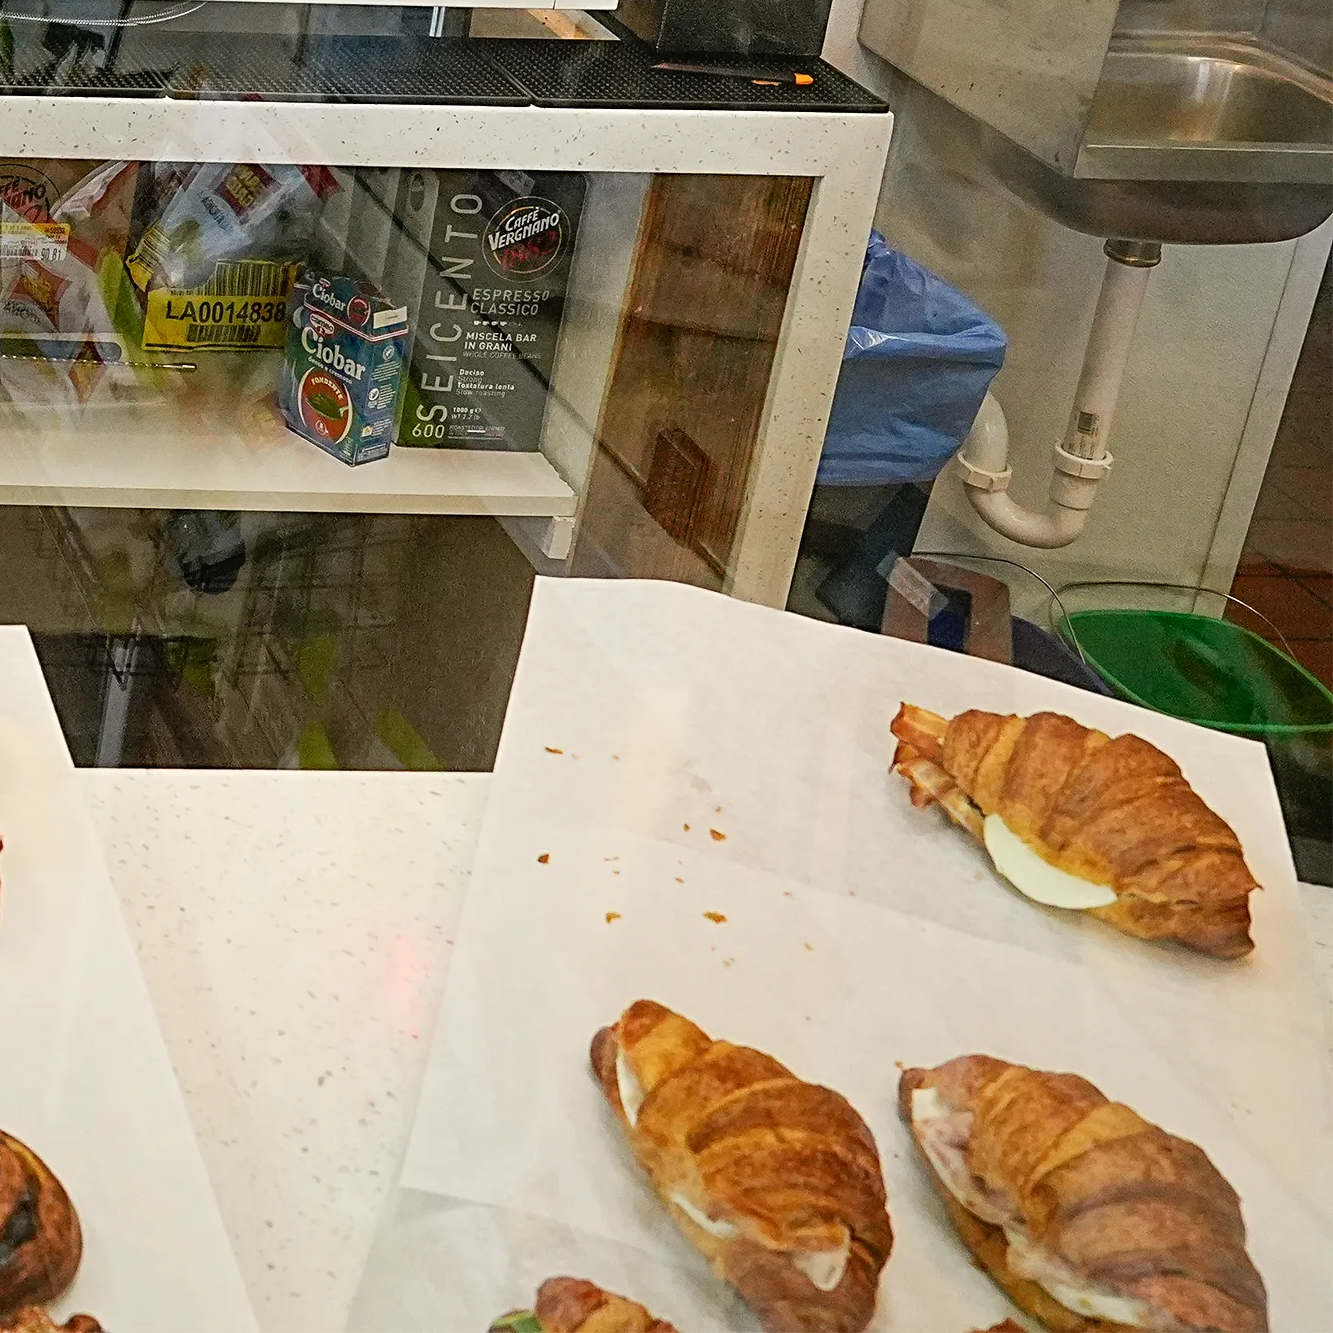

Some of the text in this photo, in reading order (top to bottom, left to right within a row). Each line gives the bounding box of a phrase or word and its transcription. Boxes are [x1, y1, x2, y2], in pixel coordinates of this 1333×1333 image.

[505, 206, 541, 233] CAFFÈ
[488, 212, 561, 252] VERGNANO
[312, 283, 347, 313] Ciobar
[472, 288, 550, 302] ESPRESSO
[165, 300, 286, 324] LA0014838
[415, 193, 483, 423] SEICENTO
[470, 302, 539, 316] CLASSICO
[464, 341, 513, 352] IN GRANI
[465, 332, 537, 343] MISCELA BAR
[301, 326, 366, 382] Ciobar
[412, 424, 445, 439] 600
